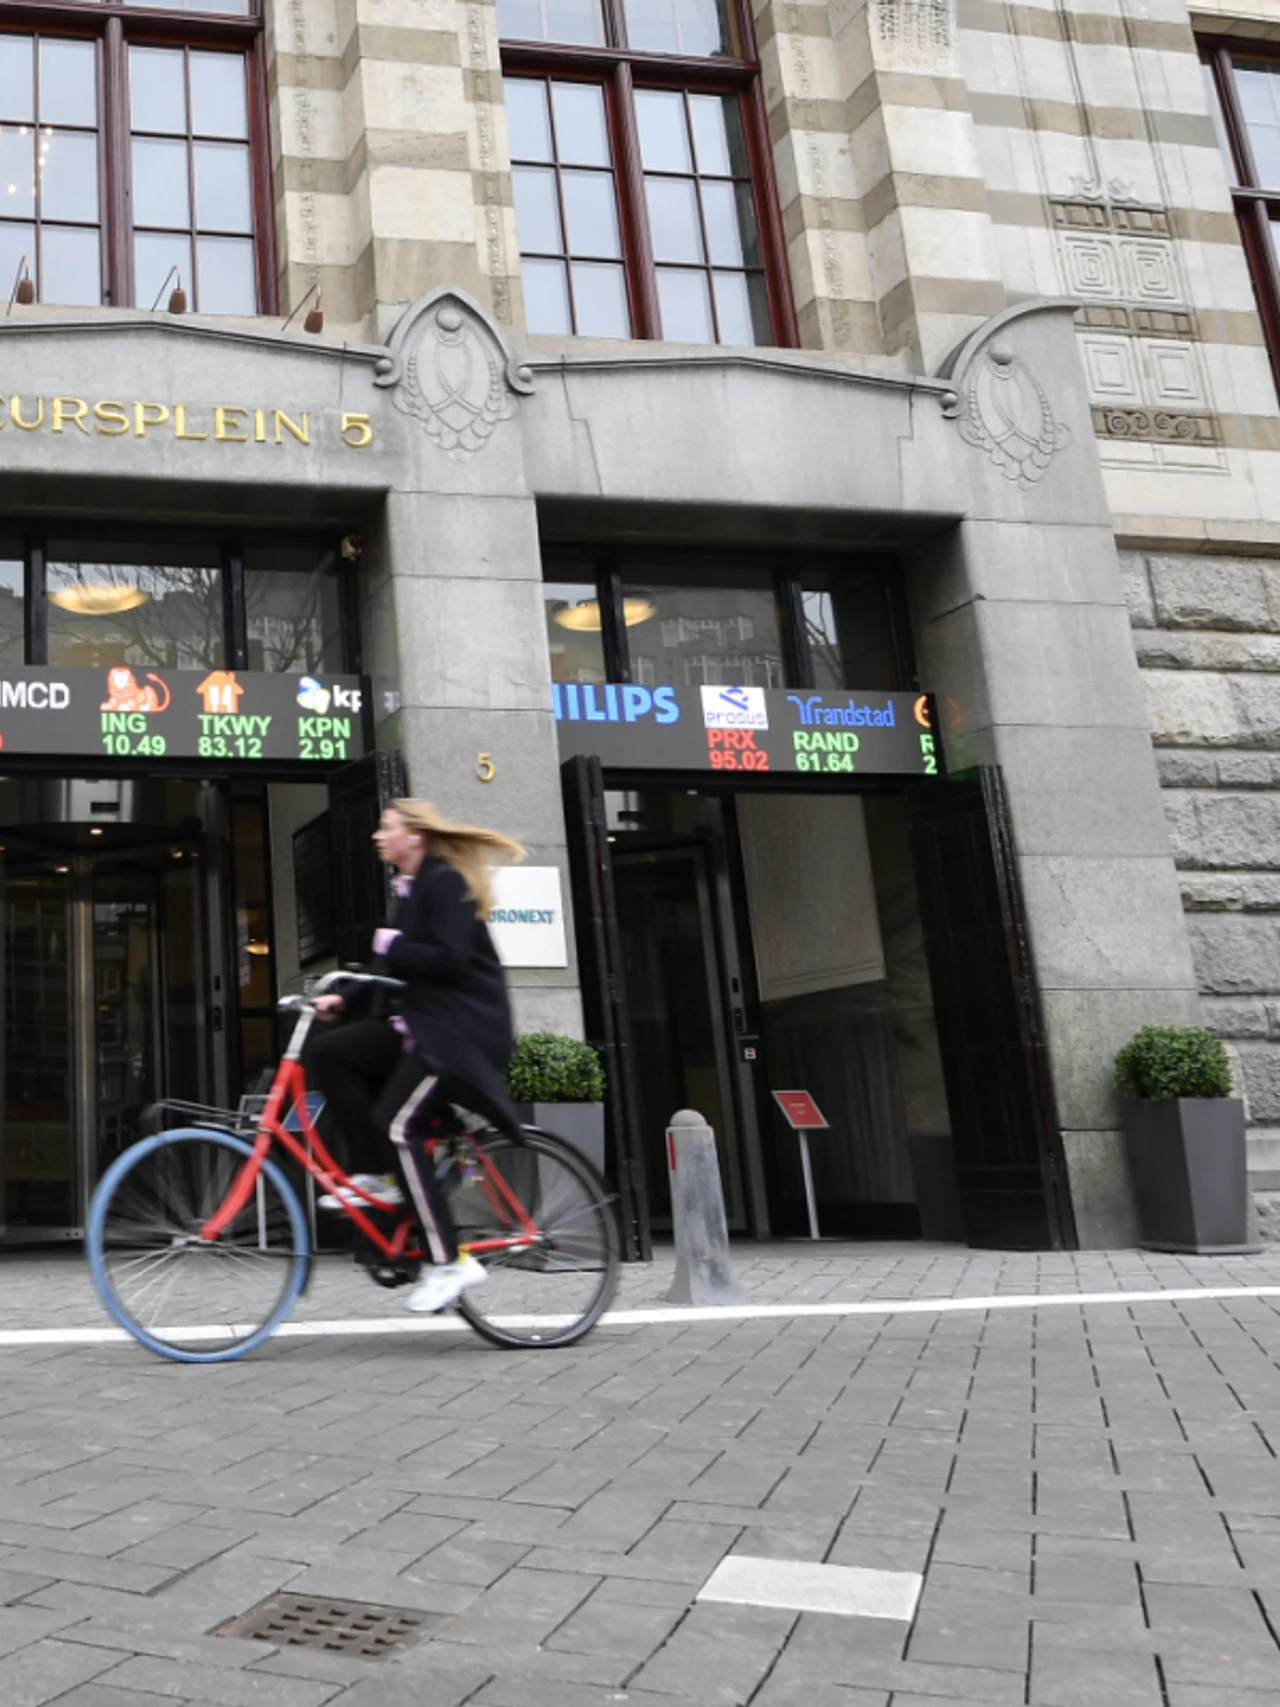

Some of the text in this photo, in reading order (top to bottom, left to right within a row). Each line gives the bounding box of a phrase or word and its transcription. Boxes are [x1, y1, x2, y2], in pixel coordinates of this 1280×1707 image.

[340, 411, 375, 447] 5
[100, 712, 147, 734] ING
[813, 699, 896, 728] randstad
[197, 714, 273, 737] TKWY
[298, 716, 352, 740] KPN
[102, 735, 168, 757] 10.49
[197, 736, 264, 759] 83.12
[298, 738, 348, 761] 2.91
[706, 728, 758, 750] PRX
[792, 730, 861, 753] RAND
[476, 752, 496, 783] 5
[708, 750, 770, 770] 95.02
[794, 753, 855, 773] 61.64
[487, 908, 554, 925] URONEXT
